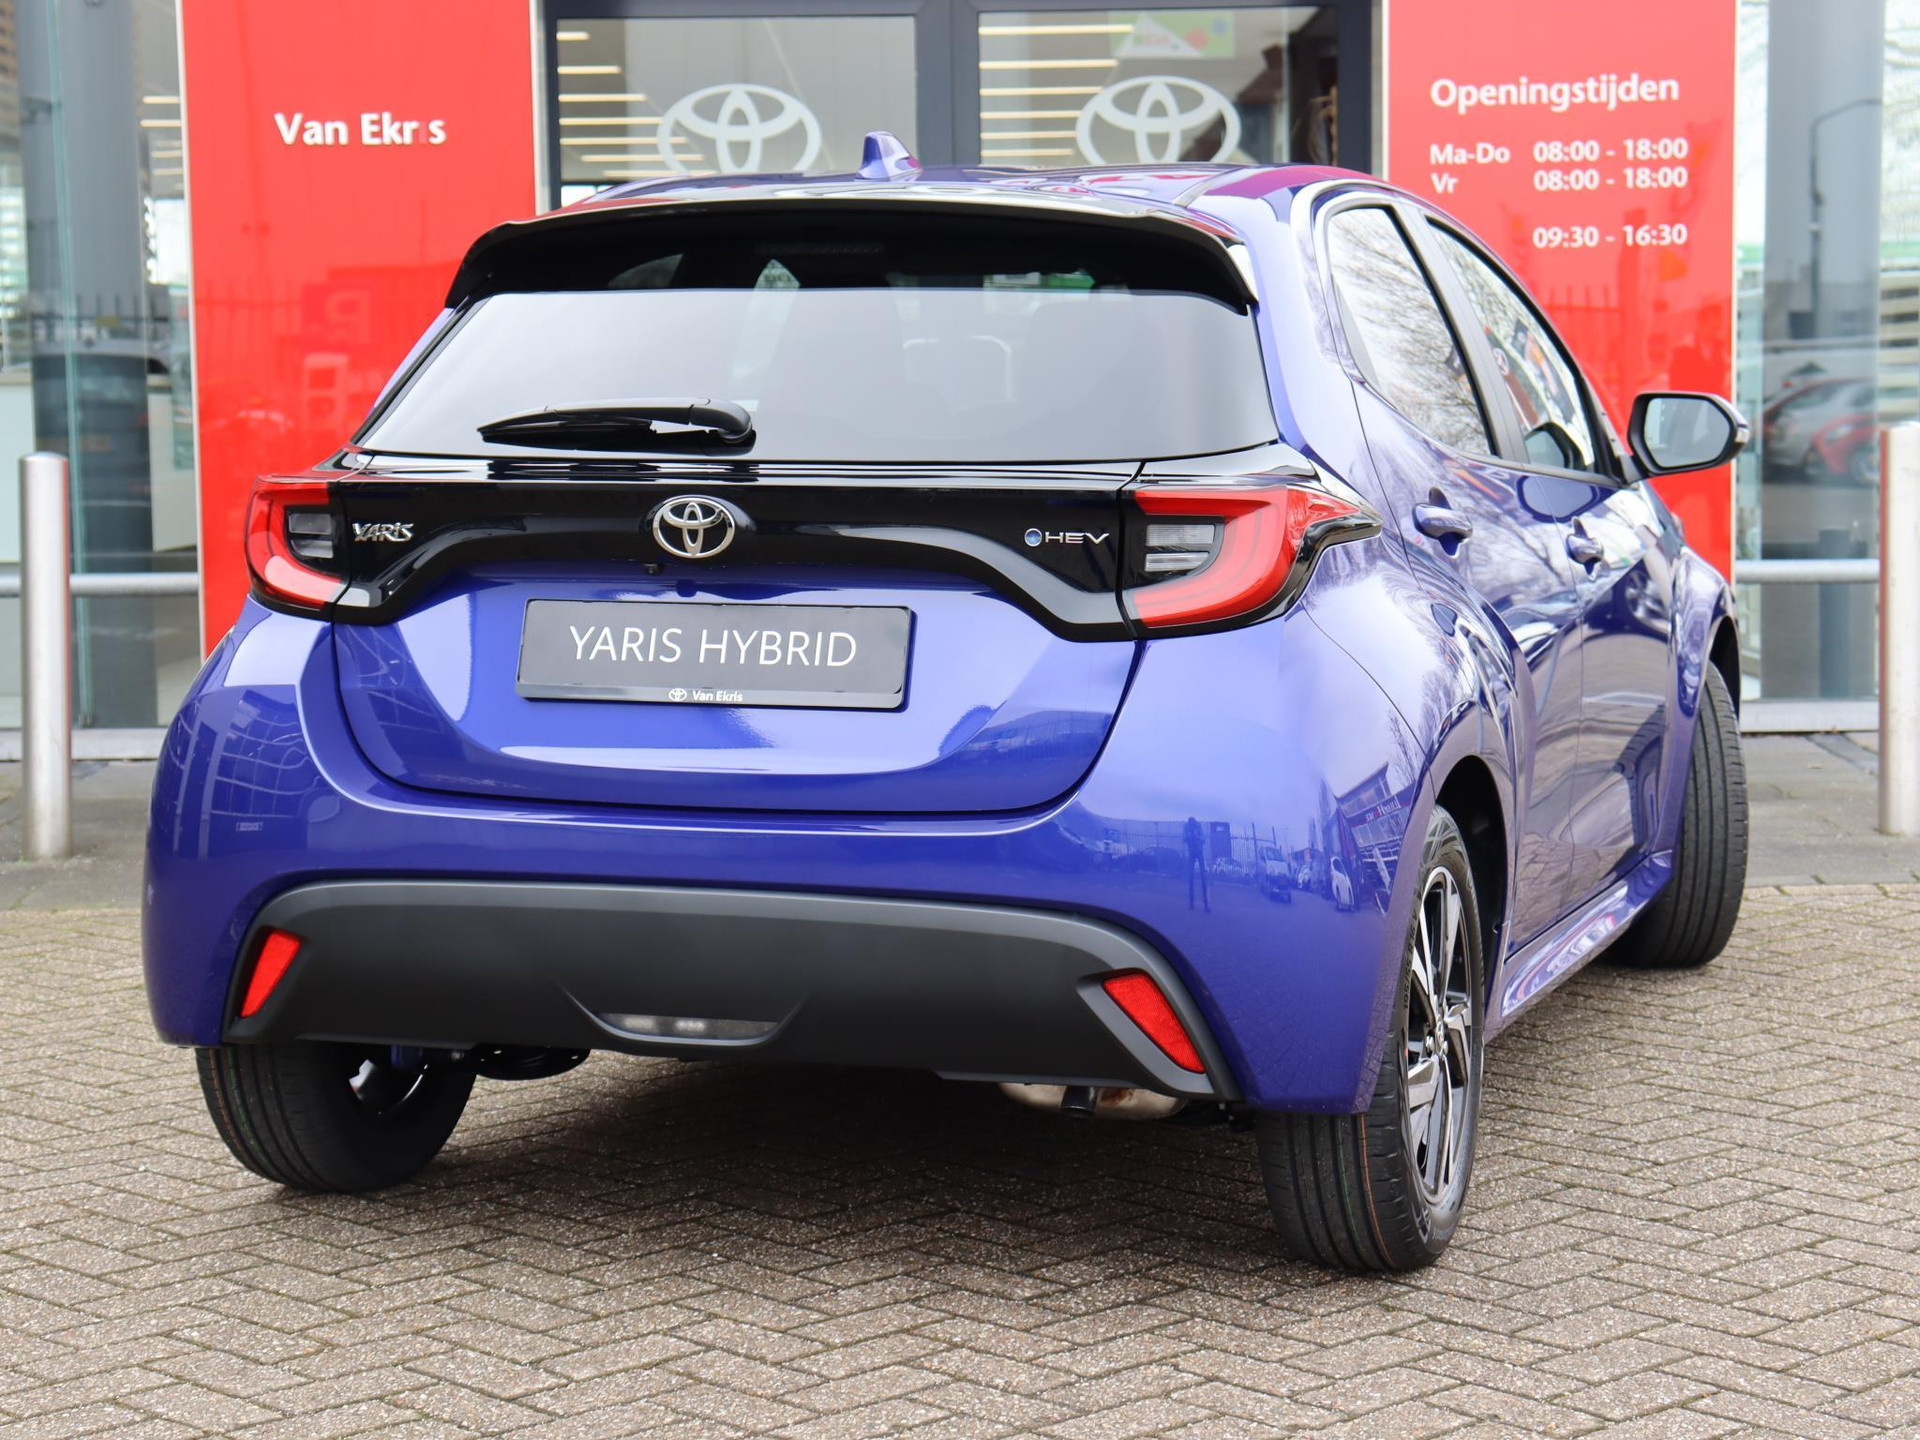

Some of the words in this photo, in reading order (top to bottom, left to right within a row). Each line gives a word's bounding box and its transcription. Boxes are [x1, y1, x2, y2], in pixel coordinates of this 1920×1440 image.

[1430, 73, 1680, 115] Openingstijden
[273, 112, 349, 145] Van
[360, 111, 447, 145] Ekrs
[1429, 142, 1511, 165] Ma-Do
[1533, 140, 1600, 163] 08:00
[1623, 137, 1689, 160] 18:00
[1430, 172, 1459, 194] Vr
[1533, 168, 1600, 191] 08:00
[1623, 166, 1689, 189] 18:00
[1532, 226, 1599, 248] 09:30
[1622, 223, 1688, 246] 16:30
[1044, 531, 1110, 545] HEV
[569, 626, 683, 663] YARIS
[699, 629, 857, 667] HYBRID
[692, 690, 713, 701] Van
[716, 690, 743, 702] Ekris
